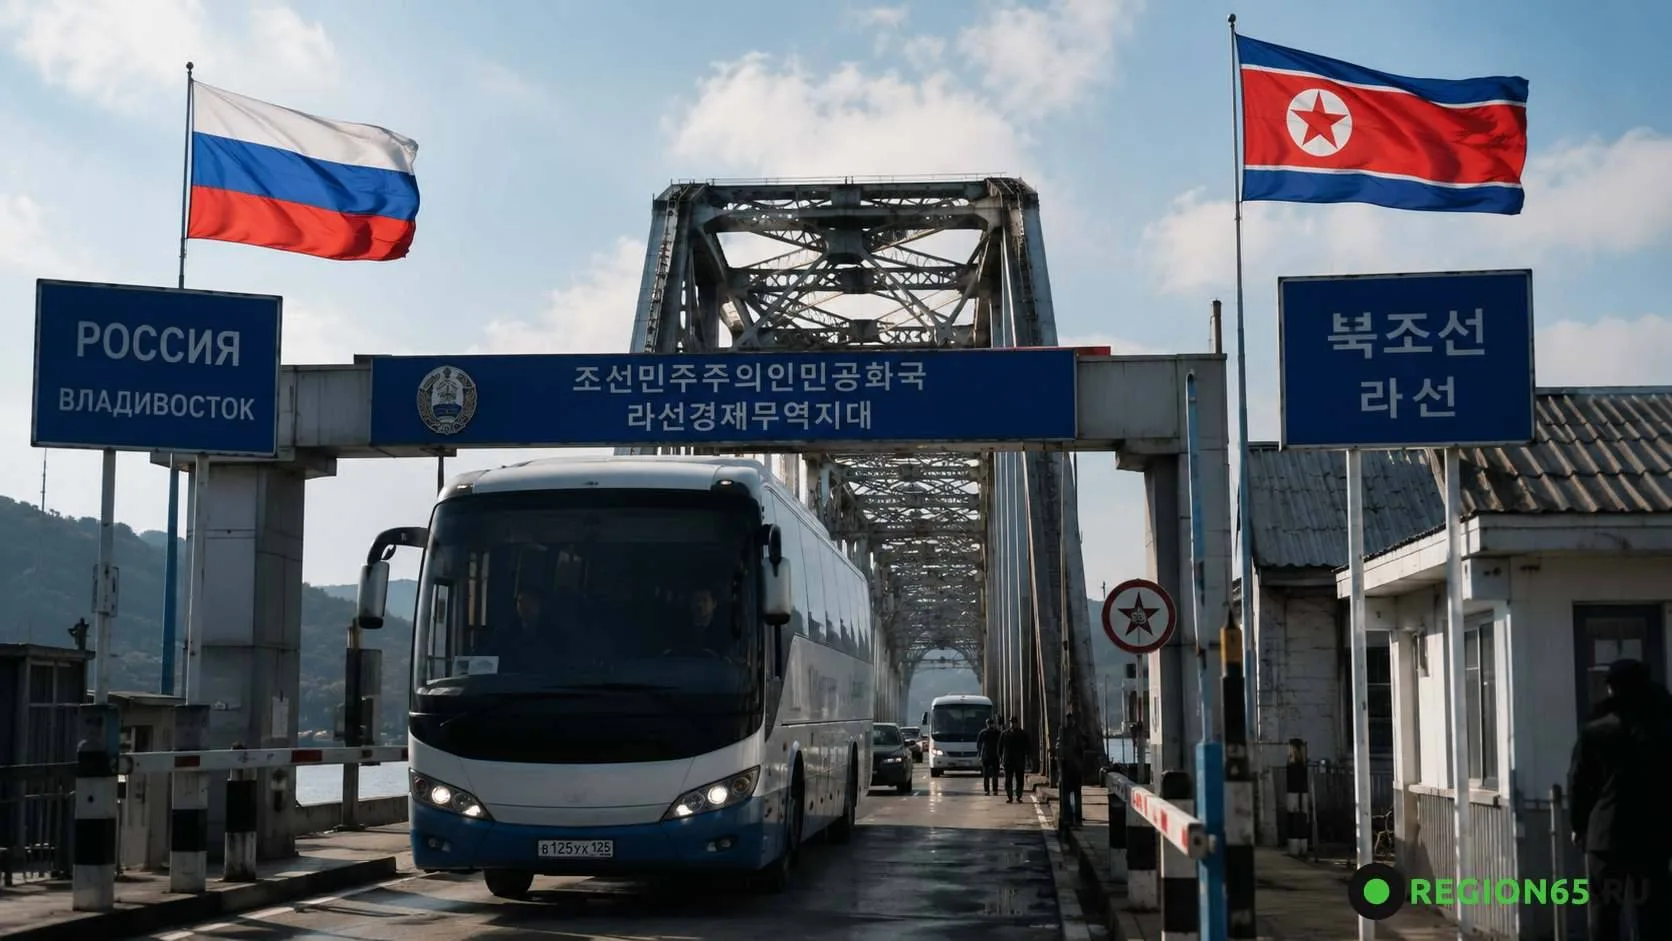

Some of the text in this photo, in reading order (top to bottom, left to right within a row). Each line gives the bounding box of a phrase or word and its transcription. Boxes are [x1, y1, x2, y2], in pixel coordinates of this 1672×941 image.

[77, 321, 240, 367] РОССИЯ
[1327, 308, 1485, 359] 북조선
[572, 361, 927, 393] 조선민주주의인민공화국
[1360, 376, 1456, 419] 라선
[59, 387, 255, 421] ВЛАДИВОСТОК
